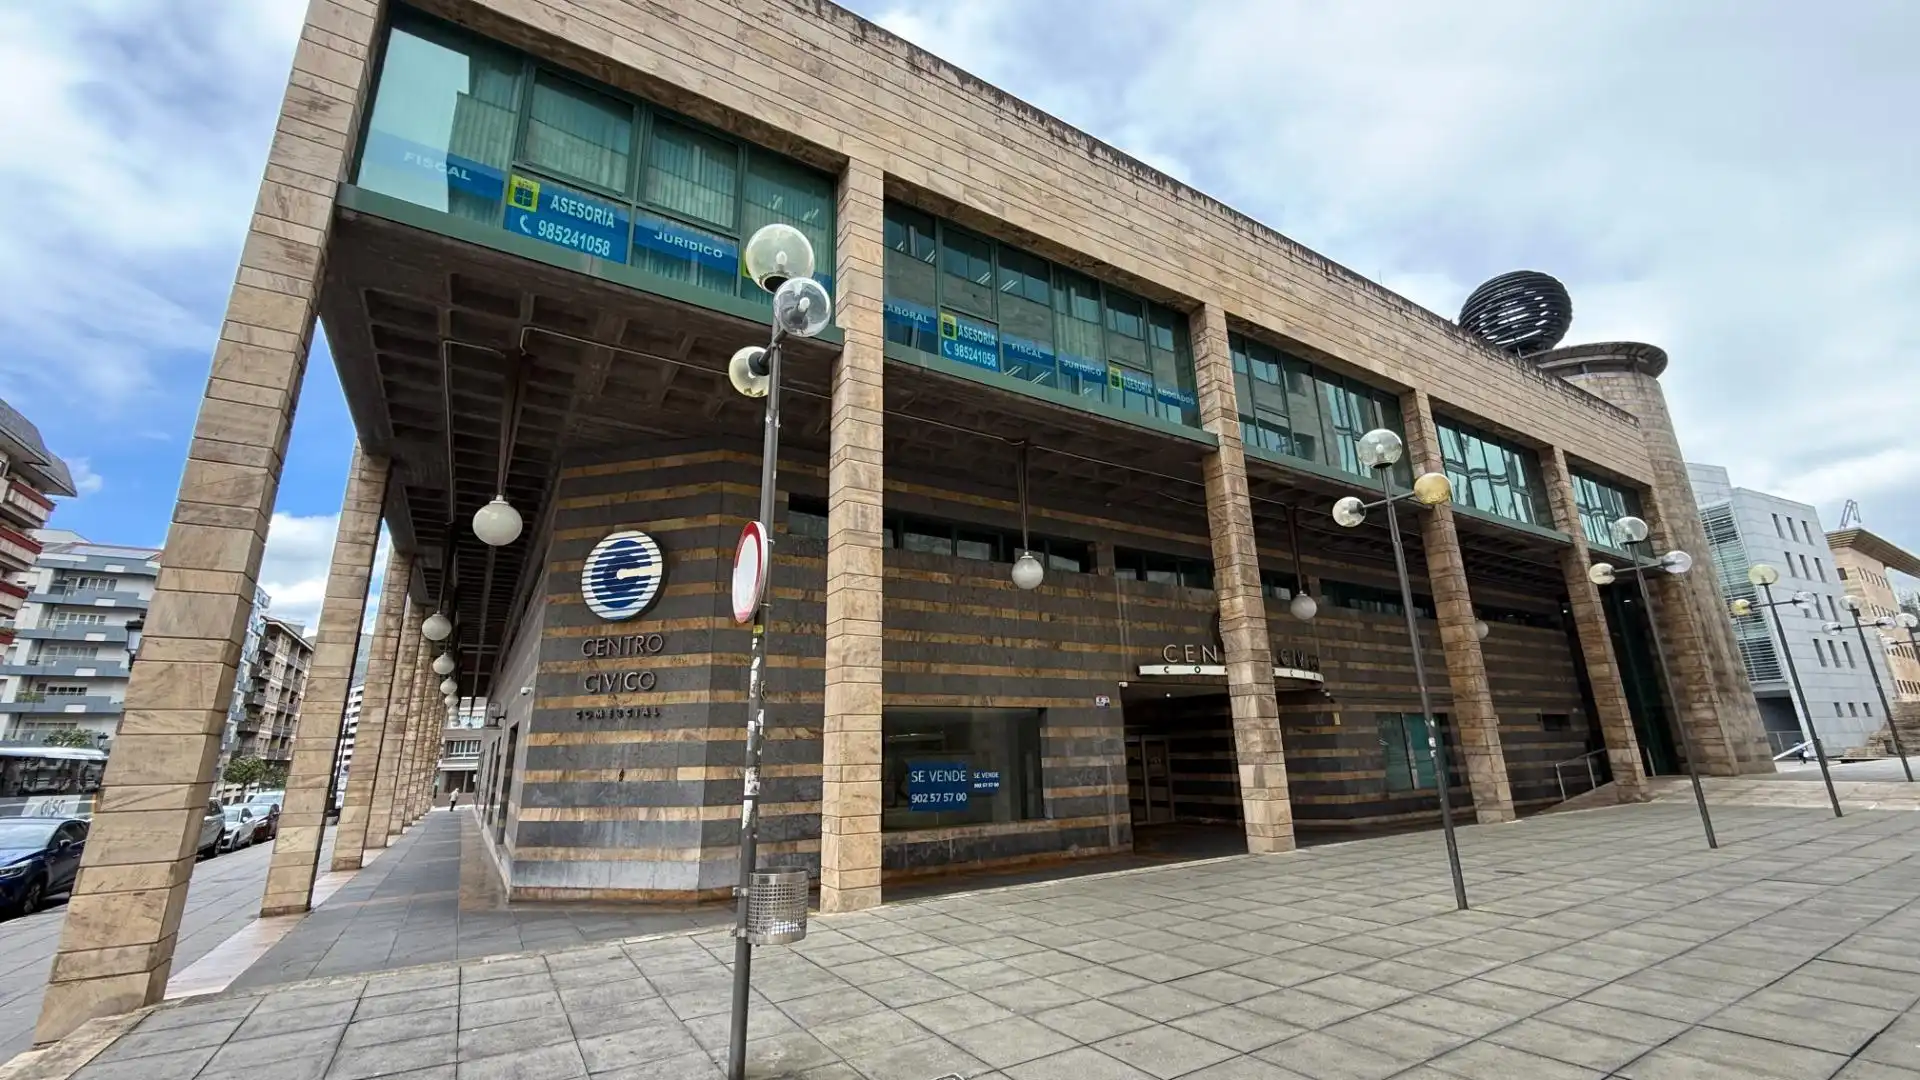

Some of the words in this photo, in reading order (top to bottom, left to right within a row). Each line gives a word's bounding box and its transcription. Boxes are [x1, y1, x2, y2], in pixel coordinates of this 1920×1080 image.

[403, 151, 472, 182] FISCAL
[550, 194, 615, 229] ASESORÍA
[537, 219, 611, 257] 985241058
[887, 303, 929, 324] ABORAL
[957, 324, 996, 348] ASESORÍA
[953, 343, 996, 368] 985241058
[1011, 343, 1043, 359] FISCAL
[581, 633, 664, 657] CENTRO
[911, 770, 925, 782] SE
[929, 769, 967, 782] VENDE
[911, 793, 928, 803] 902
[930, 793, 941, 803] 57
[943, 793, 954, 803] 57
[956, 792, 967, 802] 00
